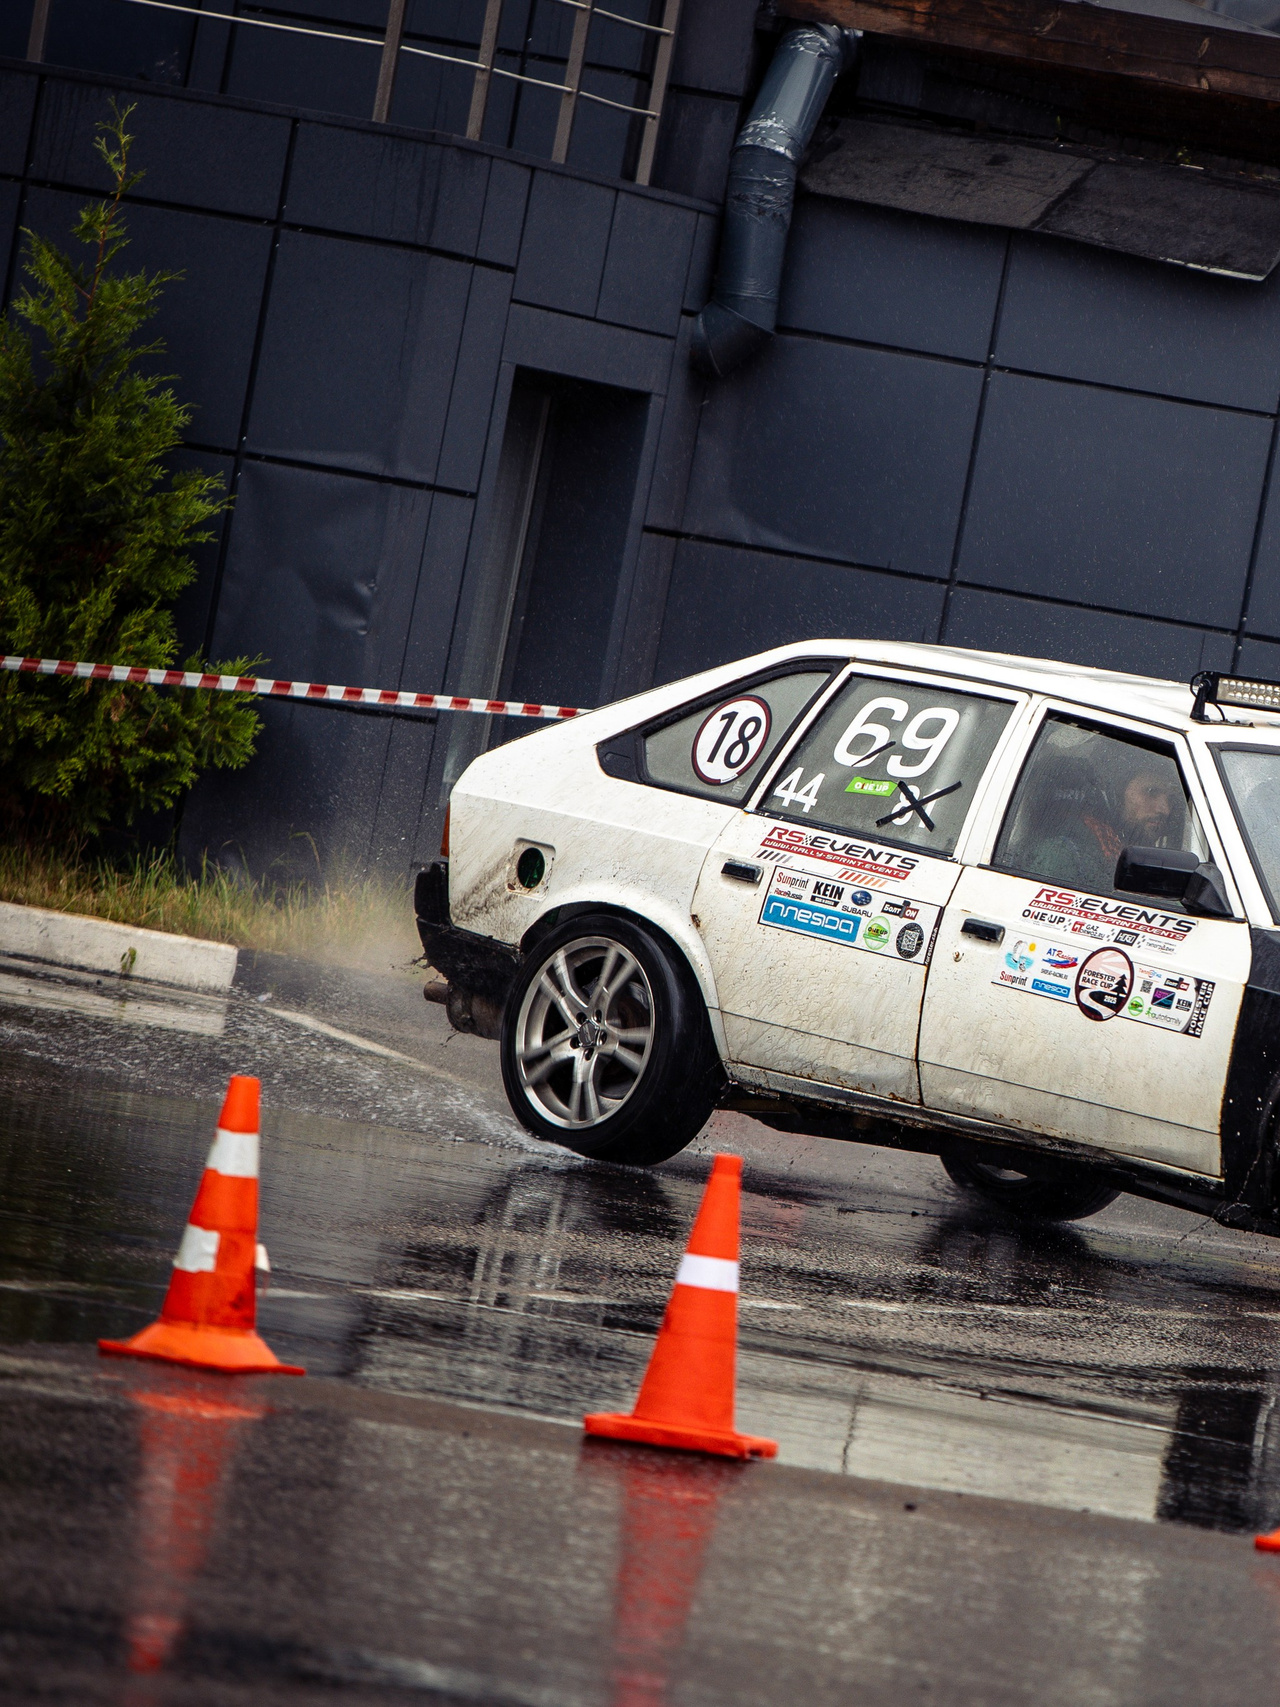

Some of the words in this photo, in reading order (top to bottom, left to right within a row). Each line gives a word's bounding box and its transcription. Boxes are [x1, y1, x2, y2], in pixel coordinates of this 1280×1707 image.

[707, 711, 762, 769] 18
[833, 696, 960, 778] 69
[773, 766, 826, 814] 44
[854, 782, 876, 792] ONE
[875, 784, 889, 793] UP
[767, 826, 806, 844] RS
[809, 835, 920, 871] EVENTS
[777, 871, 810, 889] Sunprint
[812, 881, 845, 901] KEIN
[841, 904, 873, 918] SUBARU
[1022, 908, 1048, 921] ONE
[1048, 914, 1066, 925] UP
[1034, 888, 1076, 906] RS
[1080, 898, 1197, 934] EVENTS
[1085, 923, 1100, 932] GAZ
[1000, 970, 1028, 987] Sunprint
[1081, 976, 1099, 987] RACE
[1099, 981, 1114, 989] CUP
[1083, 968, 1116, 983] FORESTER
[1188, 981, 1209, 1035] FORESTER
[1194, 1005, 1208, 1036] RACE
[1203, 983, 1214, 1006] CUP
